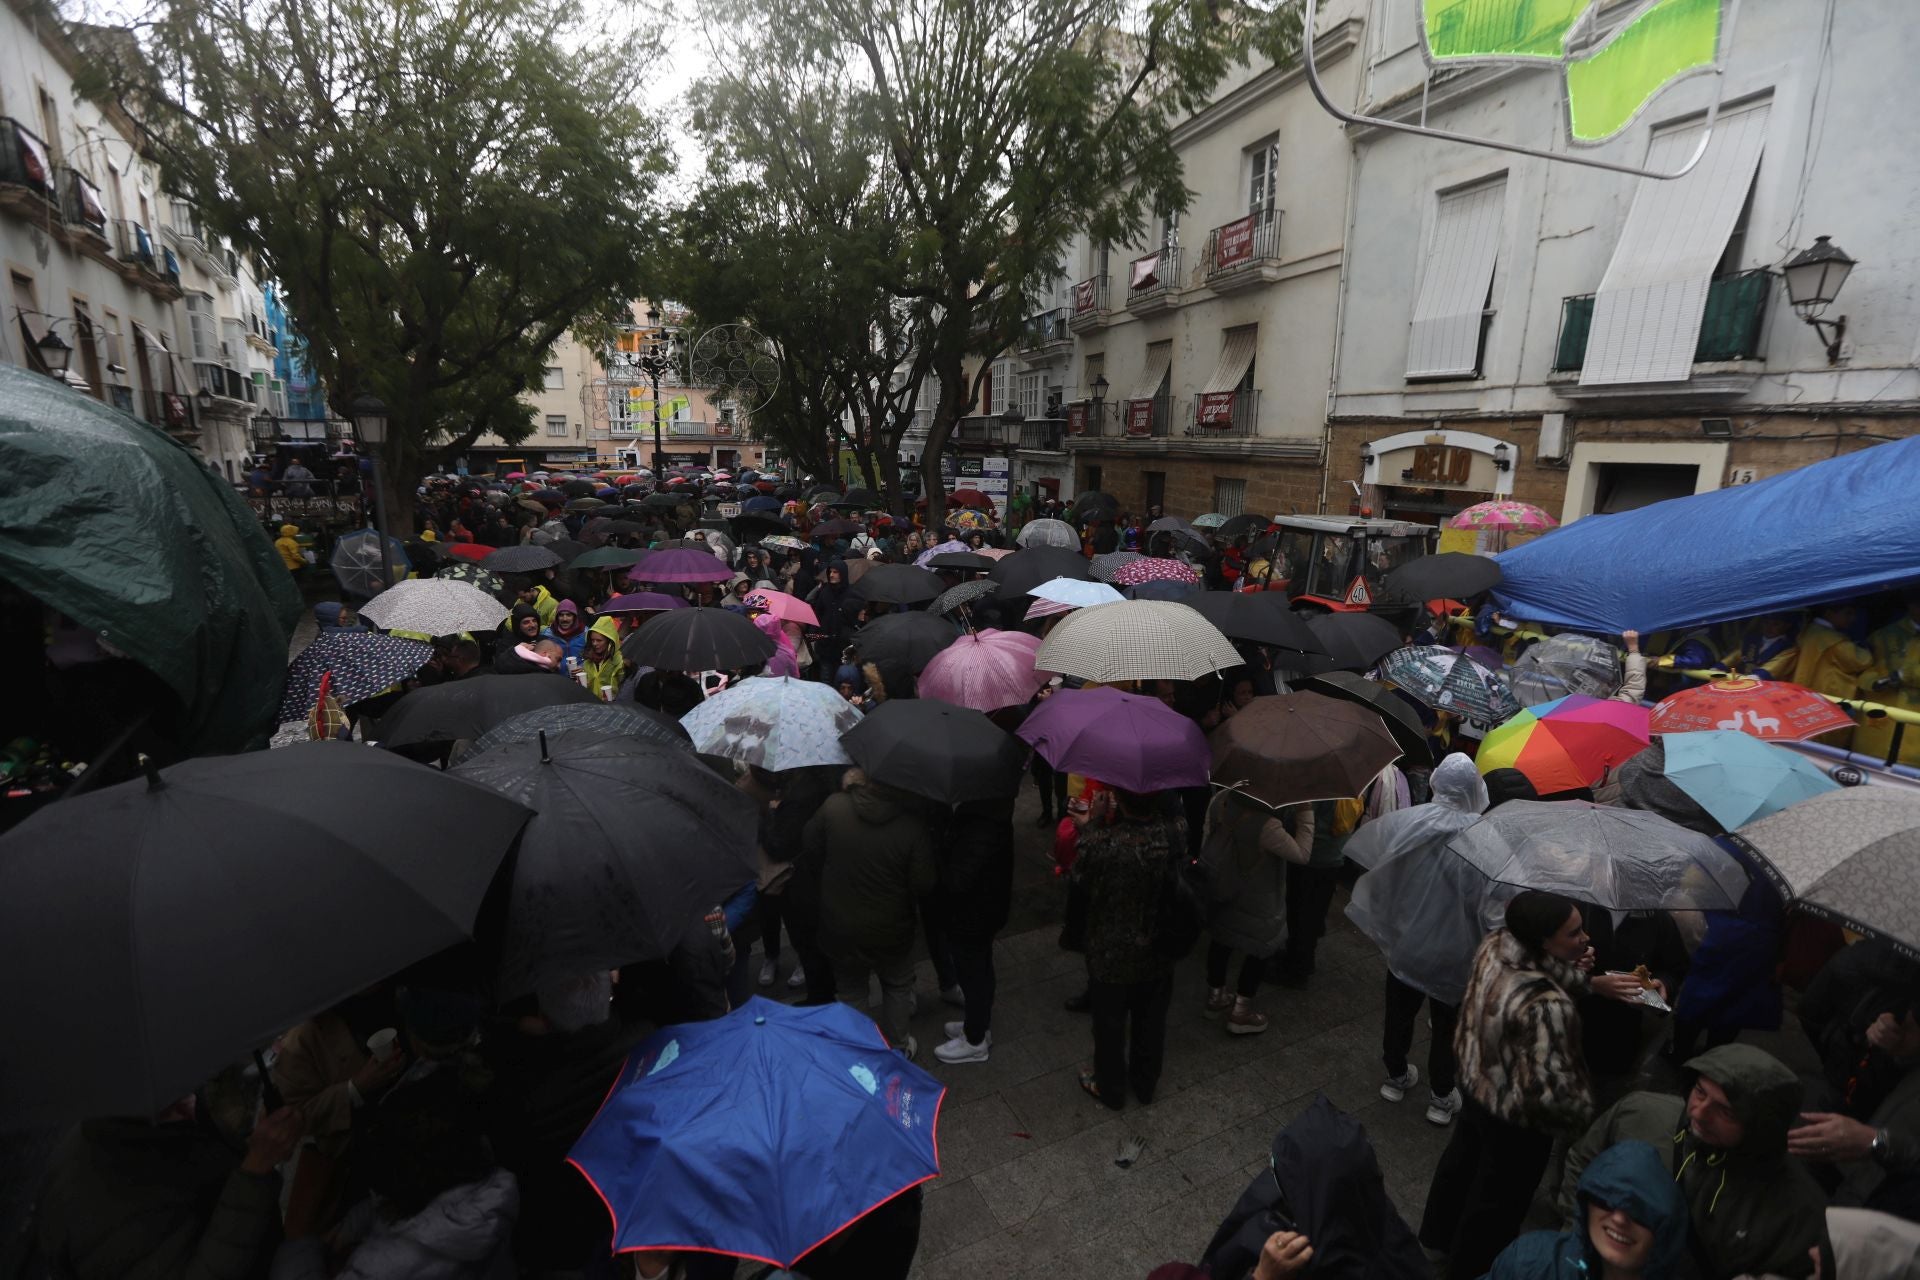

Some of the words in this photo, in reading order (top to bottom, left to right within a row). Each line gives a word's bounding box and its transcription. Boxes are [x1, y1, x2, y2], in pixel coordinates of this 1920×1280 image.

[1731, 469, 1753, 484] 15
[1353, 587, 1365, 602] 40
[1798, 902, 1830, 919] TOUS
[1844, 920, 1877, 940] TOUS
